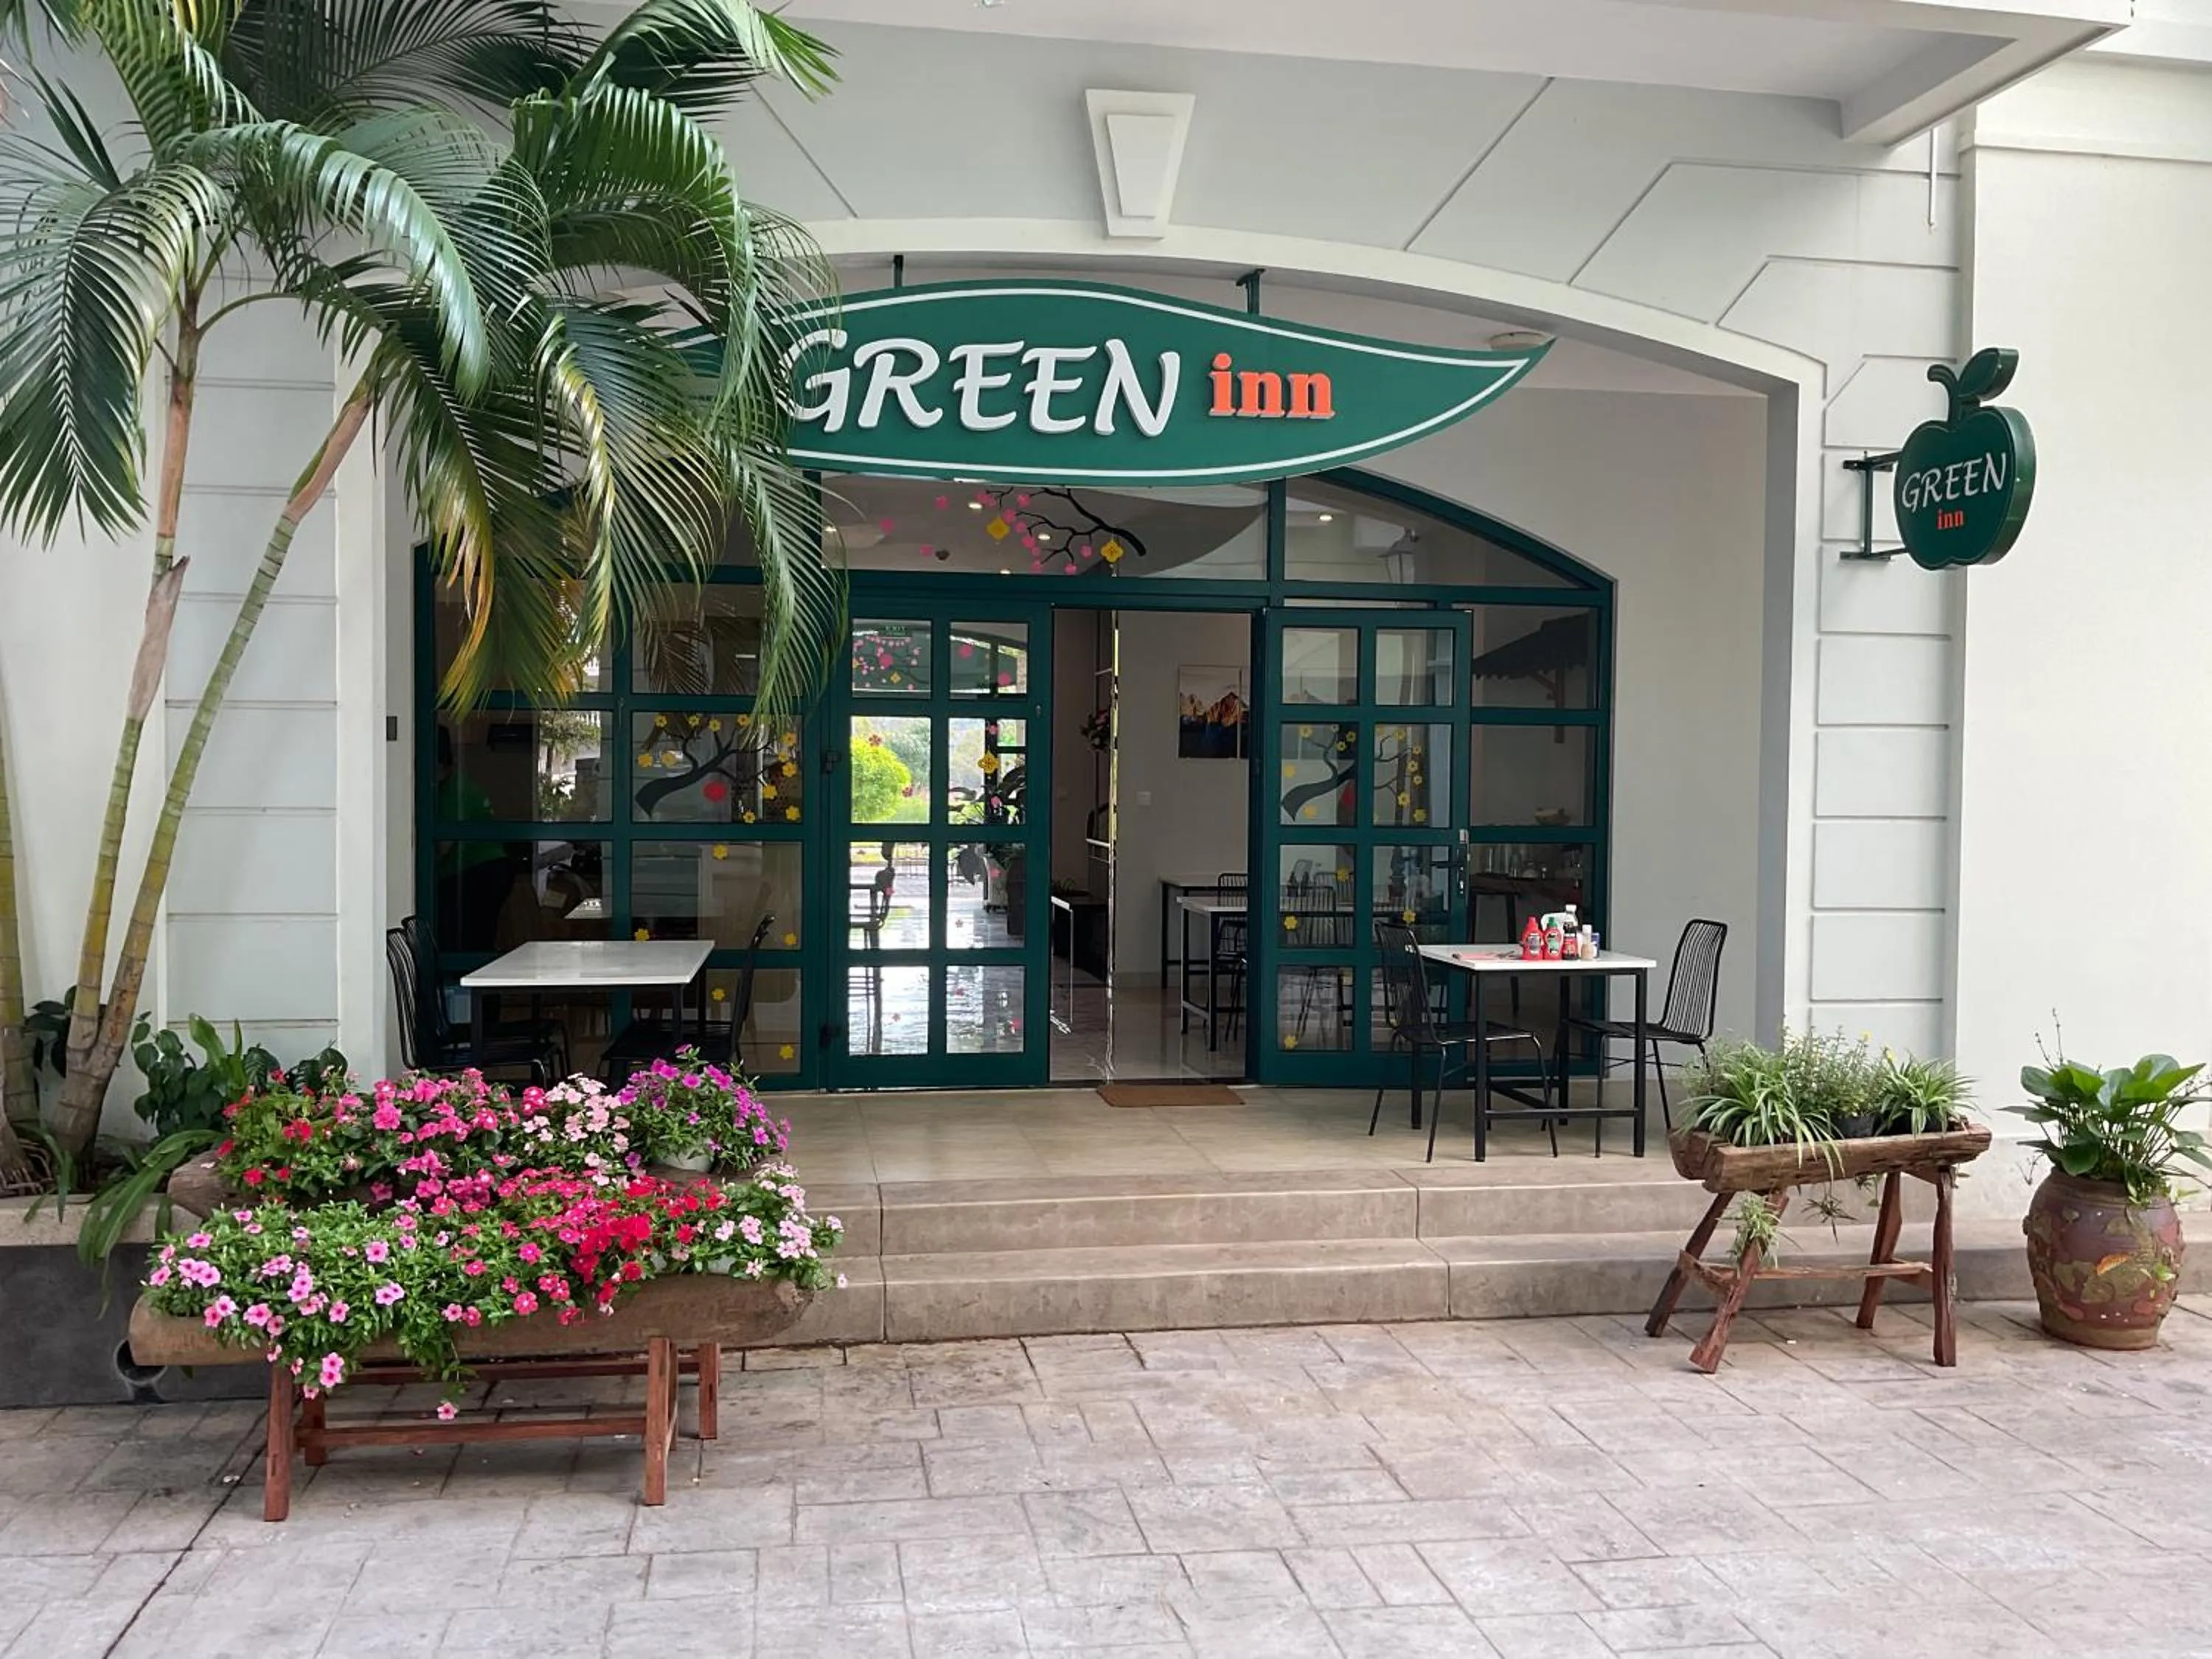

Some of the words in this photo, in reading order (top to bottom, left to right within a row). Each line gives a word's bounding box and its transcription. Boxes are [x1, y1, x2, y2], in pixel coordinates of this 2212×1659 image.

[776, 329, 1180, 437] GREEN
[1208, 353, 1335, 419] inn
[1902, 452, 2007, 512] GREEN
[1936, 509, 1964, 530] inn
